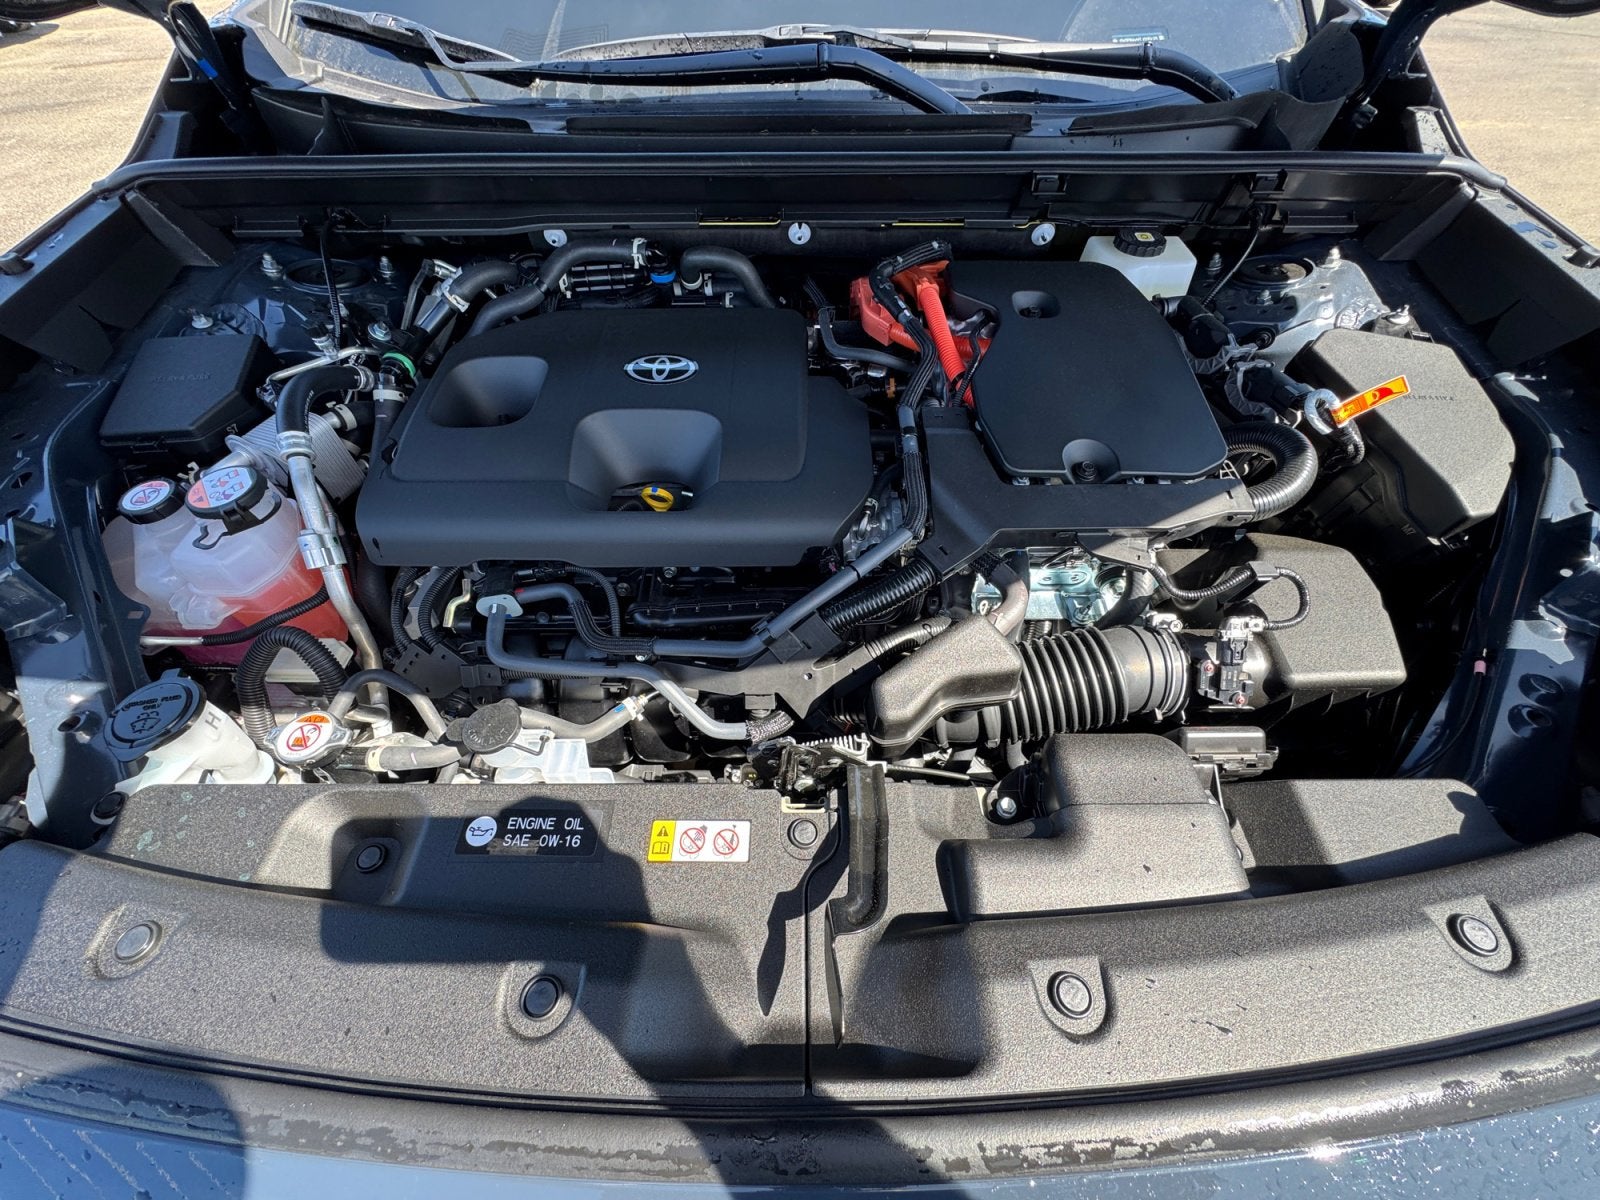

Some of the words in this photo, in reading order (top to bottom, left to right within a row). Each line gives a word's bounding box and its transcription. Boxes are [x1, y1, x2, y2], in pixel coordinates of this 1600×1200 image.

[226, 423, 239, 435] S7
[467, 727, 509, 746] COOLANT
[507, 816, 557, 830] ENGINE
[564, 816, 585, 830] OIL
[502, 834, 532, 847] SAE
[538, 834, 582, 847] 0W-16
